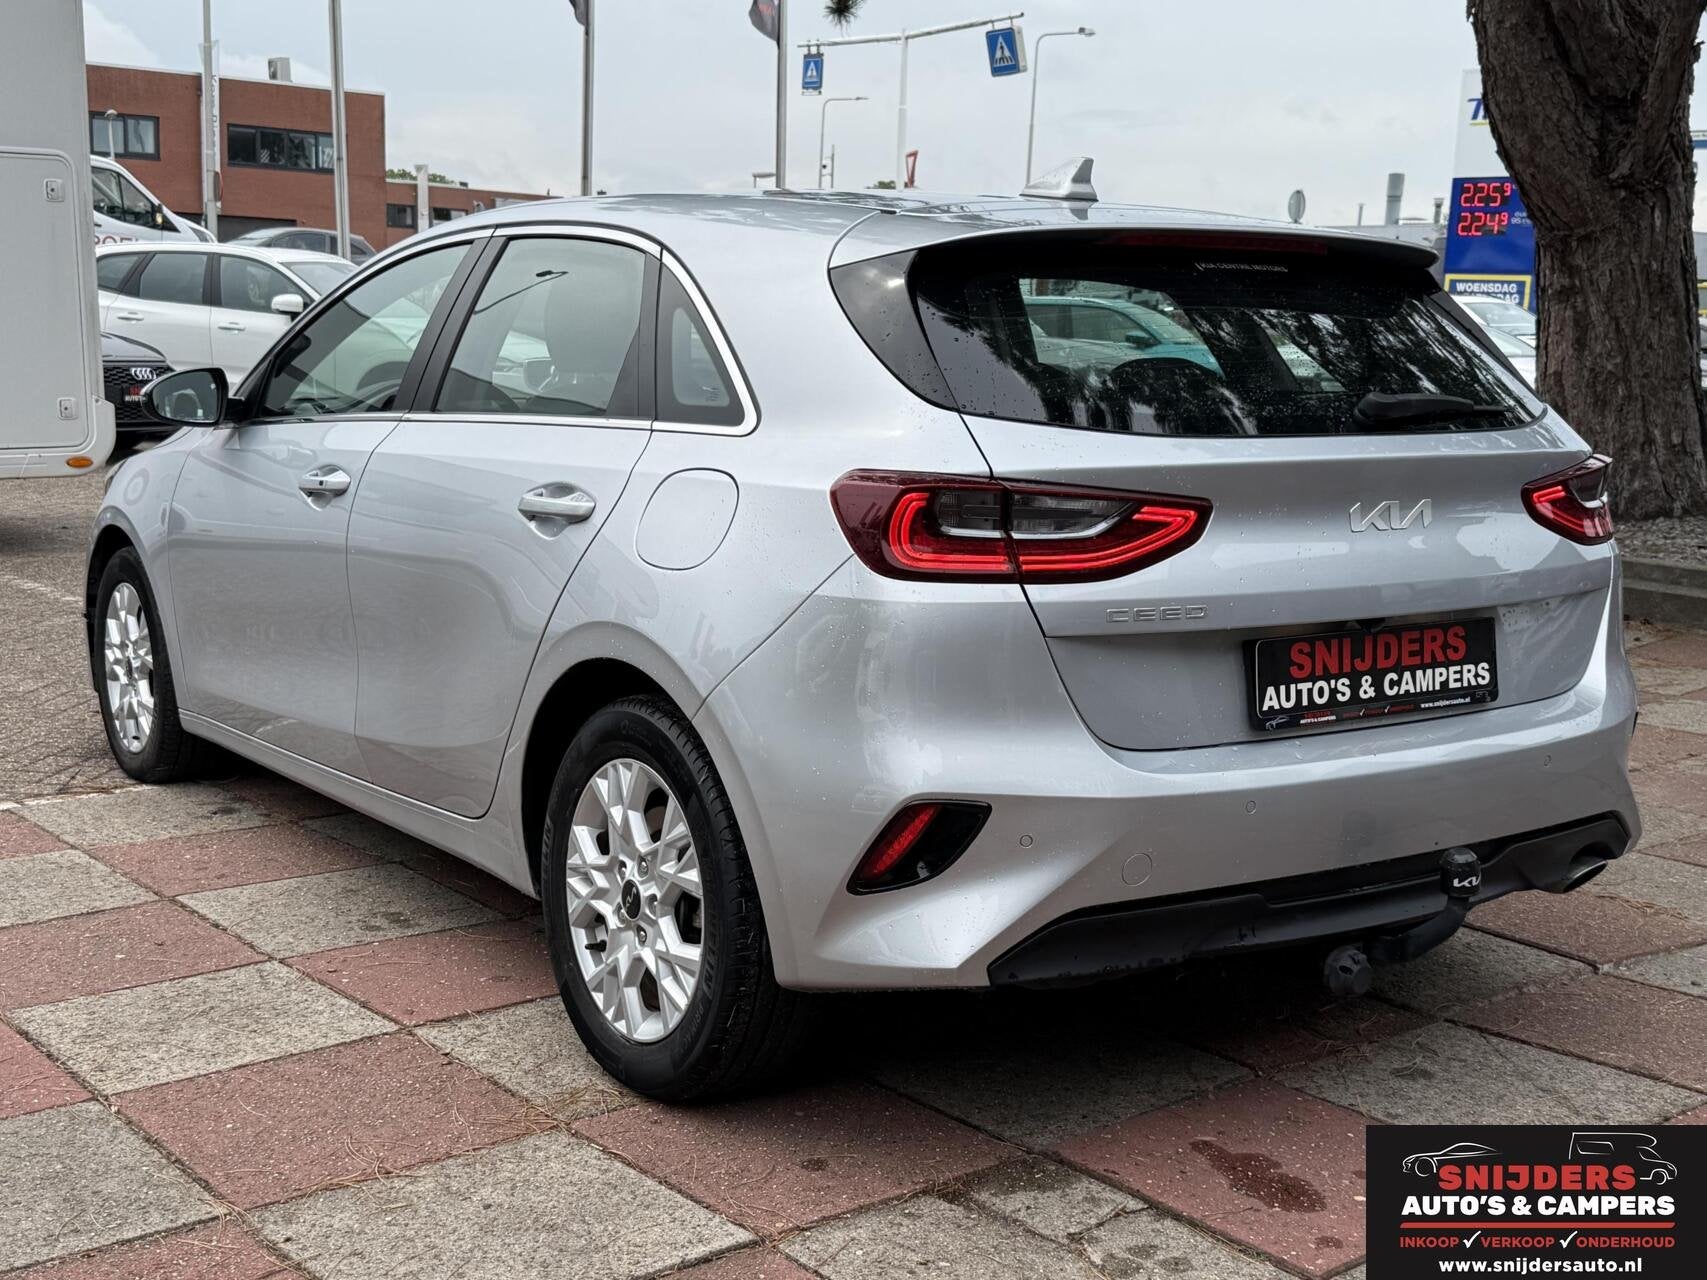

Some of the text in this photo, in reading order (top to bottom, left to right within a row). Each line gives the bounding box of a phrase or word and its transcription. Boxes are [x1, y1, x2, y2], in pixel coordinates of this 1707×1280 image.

[1456, 282, 1518, 293] WOENSDAG
[1349, 498, 1432, 533] KIA
[1105, 605, 1208, 623] CEED
[1290, 626, 1466, 678] SNIJDERS
[1262, 662, 1491, 711] AUTO'S & CAMPERS
[1420, 696, 1471, 708] www.snijdersauto.nl
